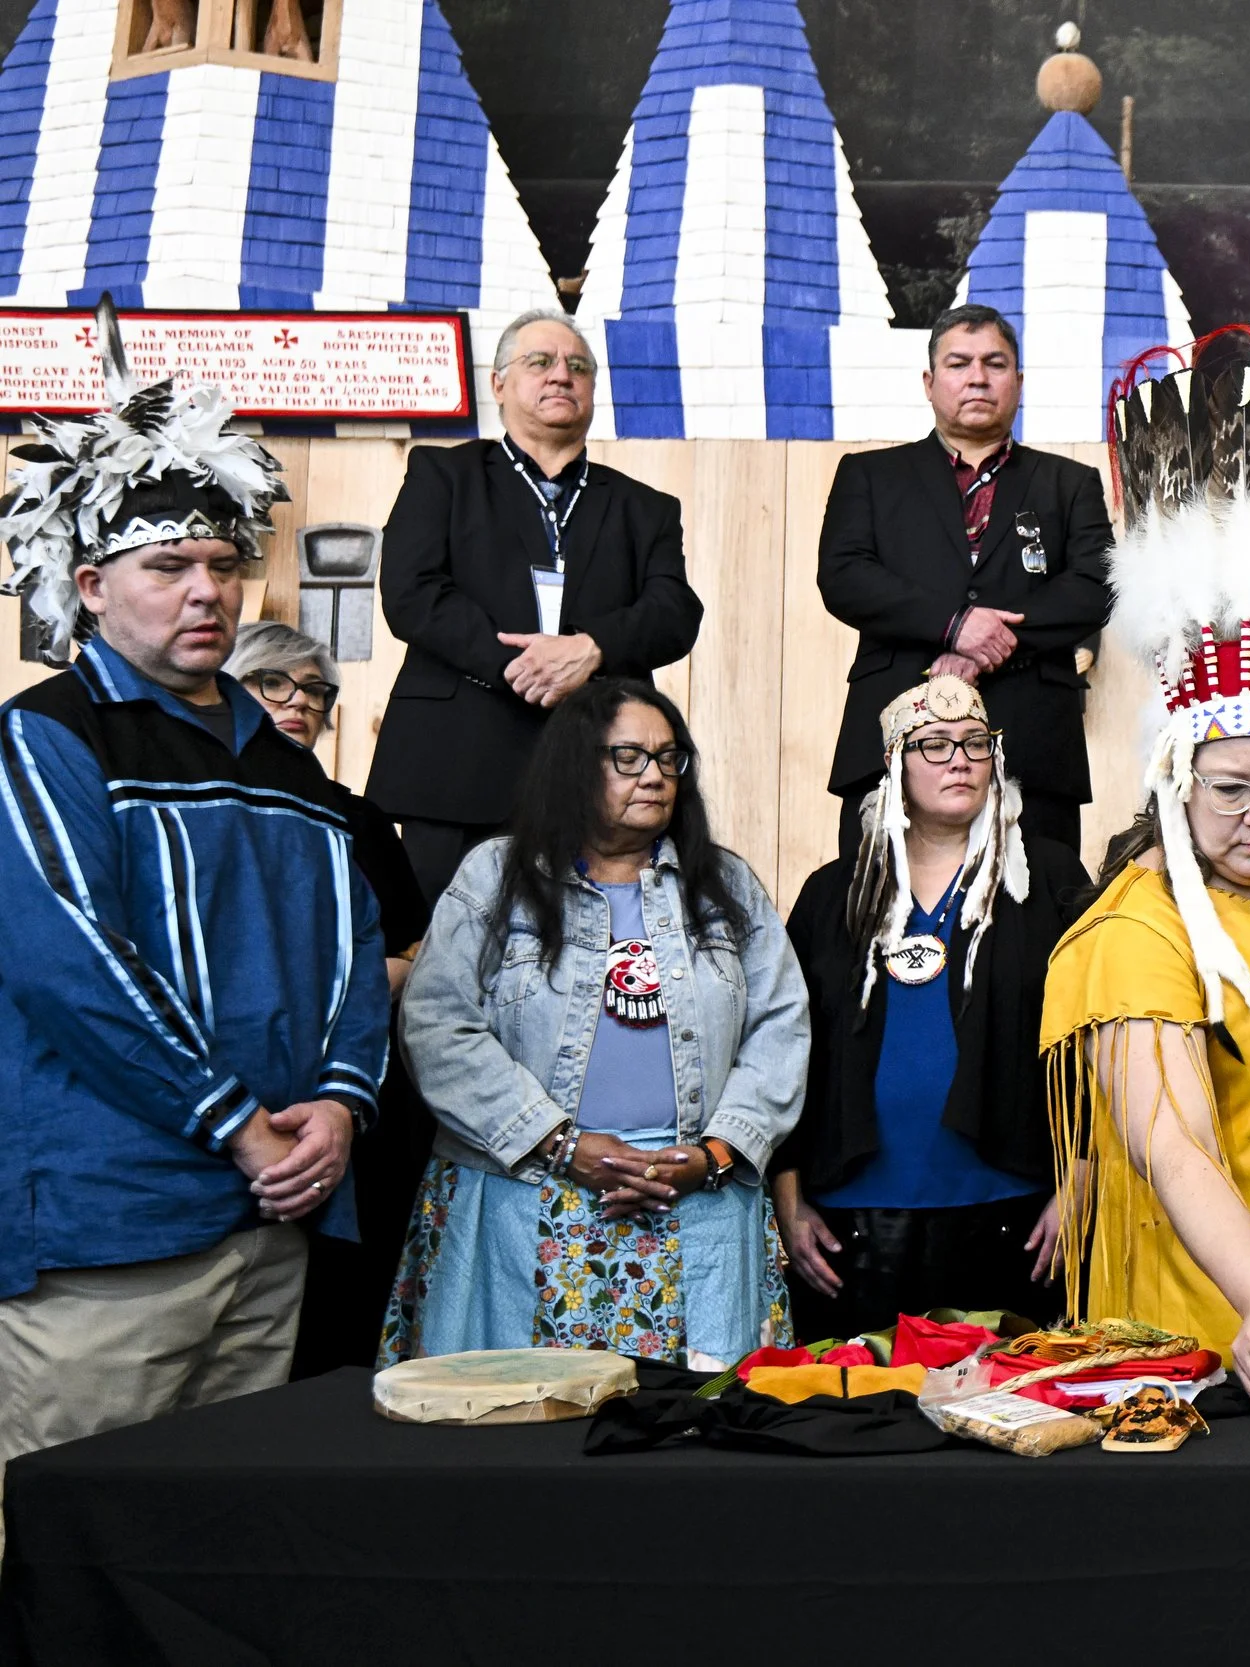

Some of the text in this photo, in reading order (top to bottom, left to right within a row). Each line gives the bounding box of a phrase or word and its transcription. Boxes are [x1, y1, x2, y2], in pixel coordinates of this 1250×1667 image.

[0, 326, 44, 336] ONEST
[142, 329, 252, 339] IN MEMORY OF
[348, 329, 423, 341] RESPECTED
[430, 332, 447, 341] BY
[124, 341, 254, 352] CHIEF CLELAMEN
[322, 341, 450, 355] BOTH WHITES AND
[134, 356, 166, 366] DIED
[175, 356, 209, 367] JULY
[219, 357, 246, 369] 1893
[262, 357, 296, 368] AGED
[326, 359, 367, 370] YEARS
[398, 356, 449, 367] INDIANS
[3, 365, 22, 375] HE
[33, 366, 69, 376] GAVE
[201, 370, 237, 380] HELP
[241, 371, 259, 381] OF
[263, 371, 287, 382] HIS
[293, 372, 326, 383] SONS
[336, 374, 414, 385] ALEXANDER
[422, 375, 432, 384] &
[72, 379, 86, 389] IN
[259, 383, 311, 395] VALUED
[319, 385, 335, 395] AT
[388, 387, 448, 398] DOLLARS
[18, 390, 41, 401] HIS
[46, 390, 96, 402] EIGHTH
[235, 395, 275, 406] FEAST
[283, 396, 318, 407] THAT
[324, 398, 341, 408] HE
[348, 399, 376, 408] HAD
[381, 399, 419, 409] HELD
